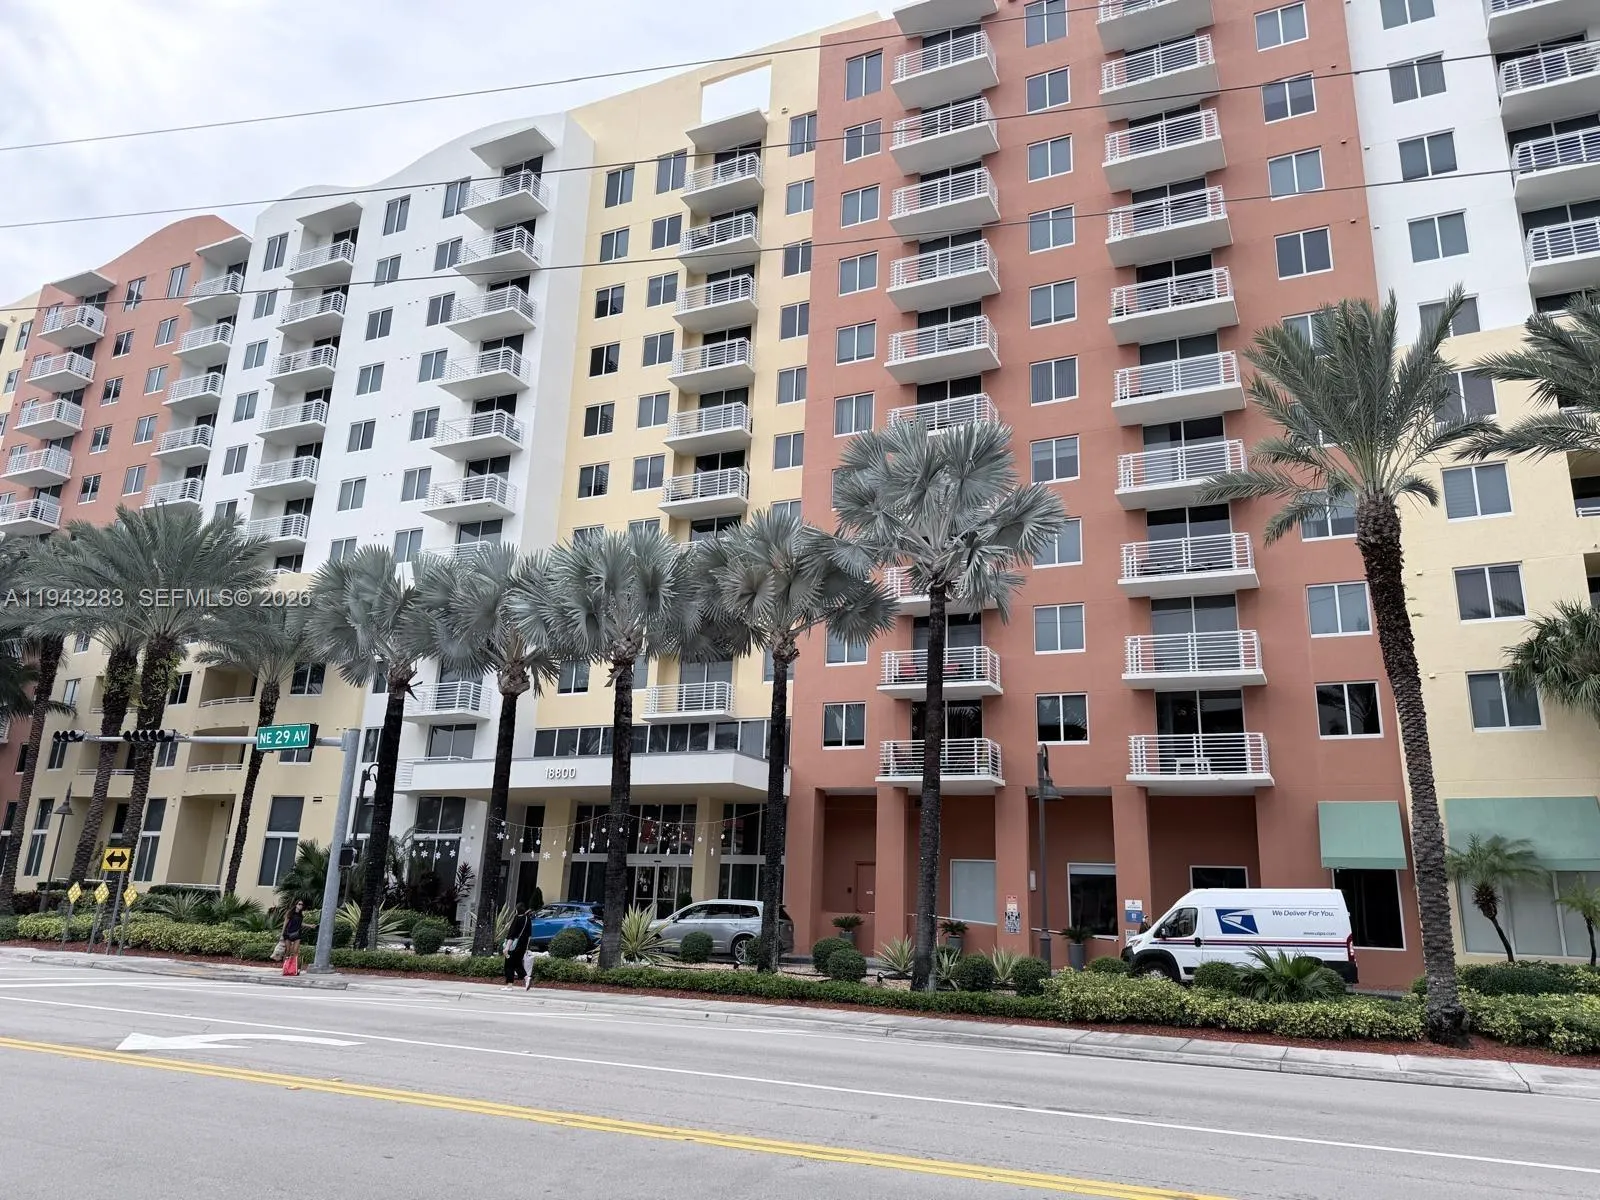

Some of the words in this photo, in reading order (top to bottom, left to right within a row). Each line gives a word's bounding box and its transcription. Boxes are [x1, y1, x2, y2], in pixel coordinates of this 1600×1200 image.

[259, 732, 272, 744] NE
[275, 730, 290, 744] 29
[293, 730, 307, 742] AV
[544, 767, 577, 779] 18800
